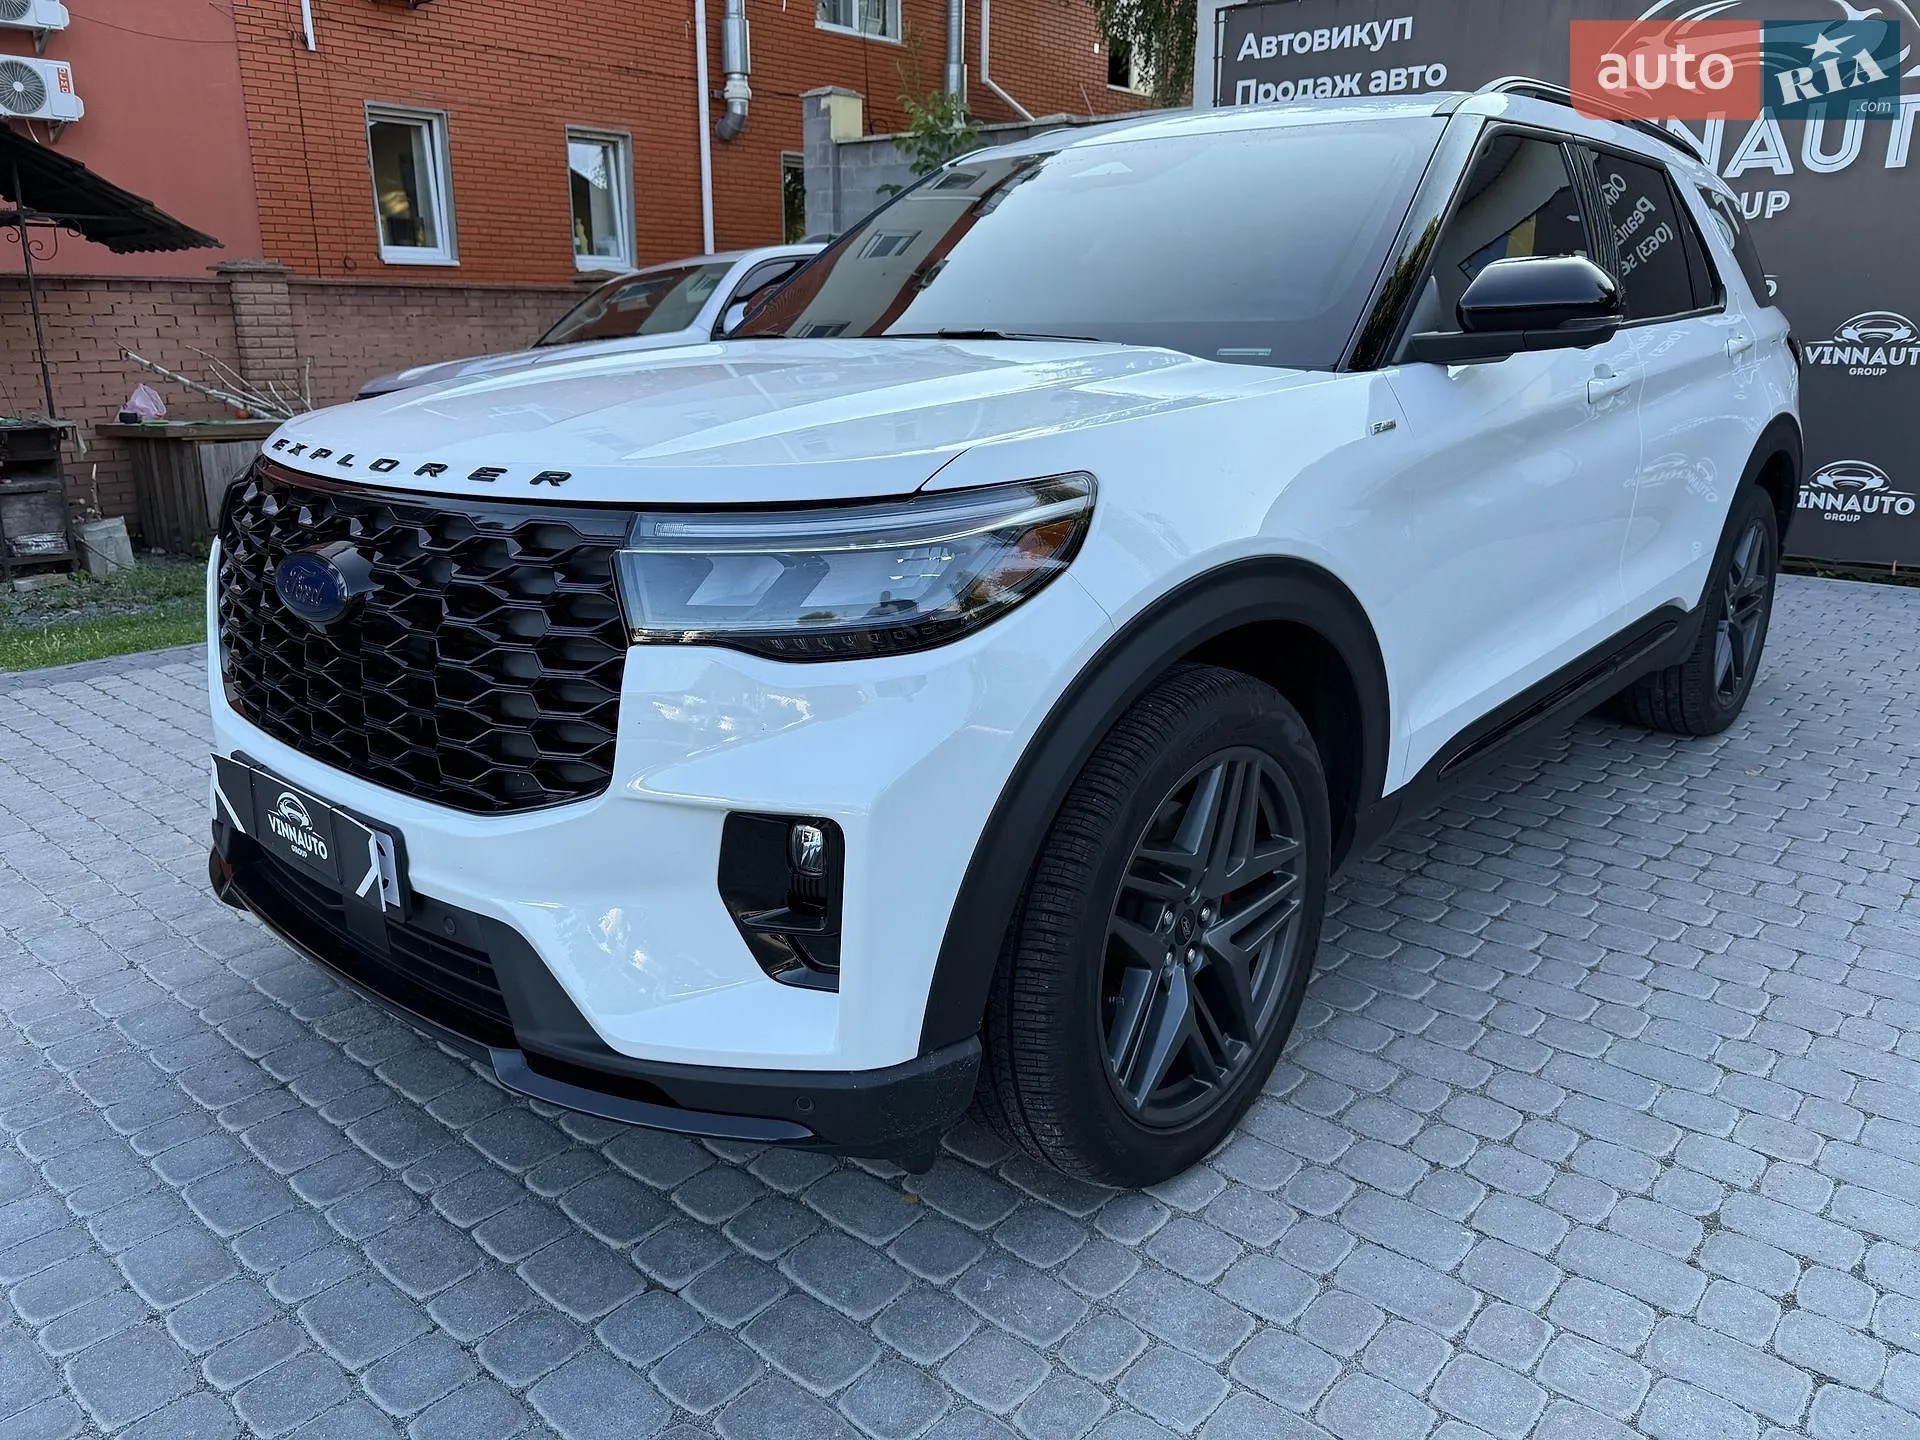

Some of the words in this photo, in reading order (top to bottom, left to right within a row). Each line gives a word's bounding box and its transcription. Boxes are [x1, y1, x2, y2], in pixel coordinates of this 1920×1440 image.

[1237, 16, 1413, 61] Автовикуп
[1235, 71, 1363, 105] Продаж
[1368, 63, 1448, 94] авто
[1805, 346, 1920, 366] VINNAUT
[1849, 367, 1887, 376] GROUP
[271, 438, 572, 487] EXPLORER
[1797, 491, 1915, 516] INNAUTO
[1824, 512, 1861, 522] GROUP
[268, 813, 328, 860] VINNAUTO
[291, 844, 308, 859] GROUP
